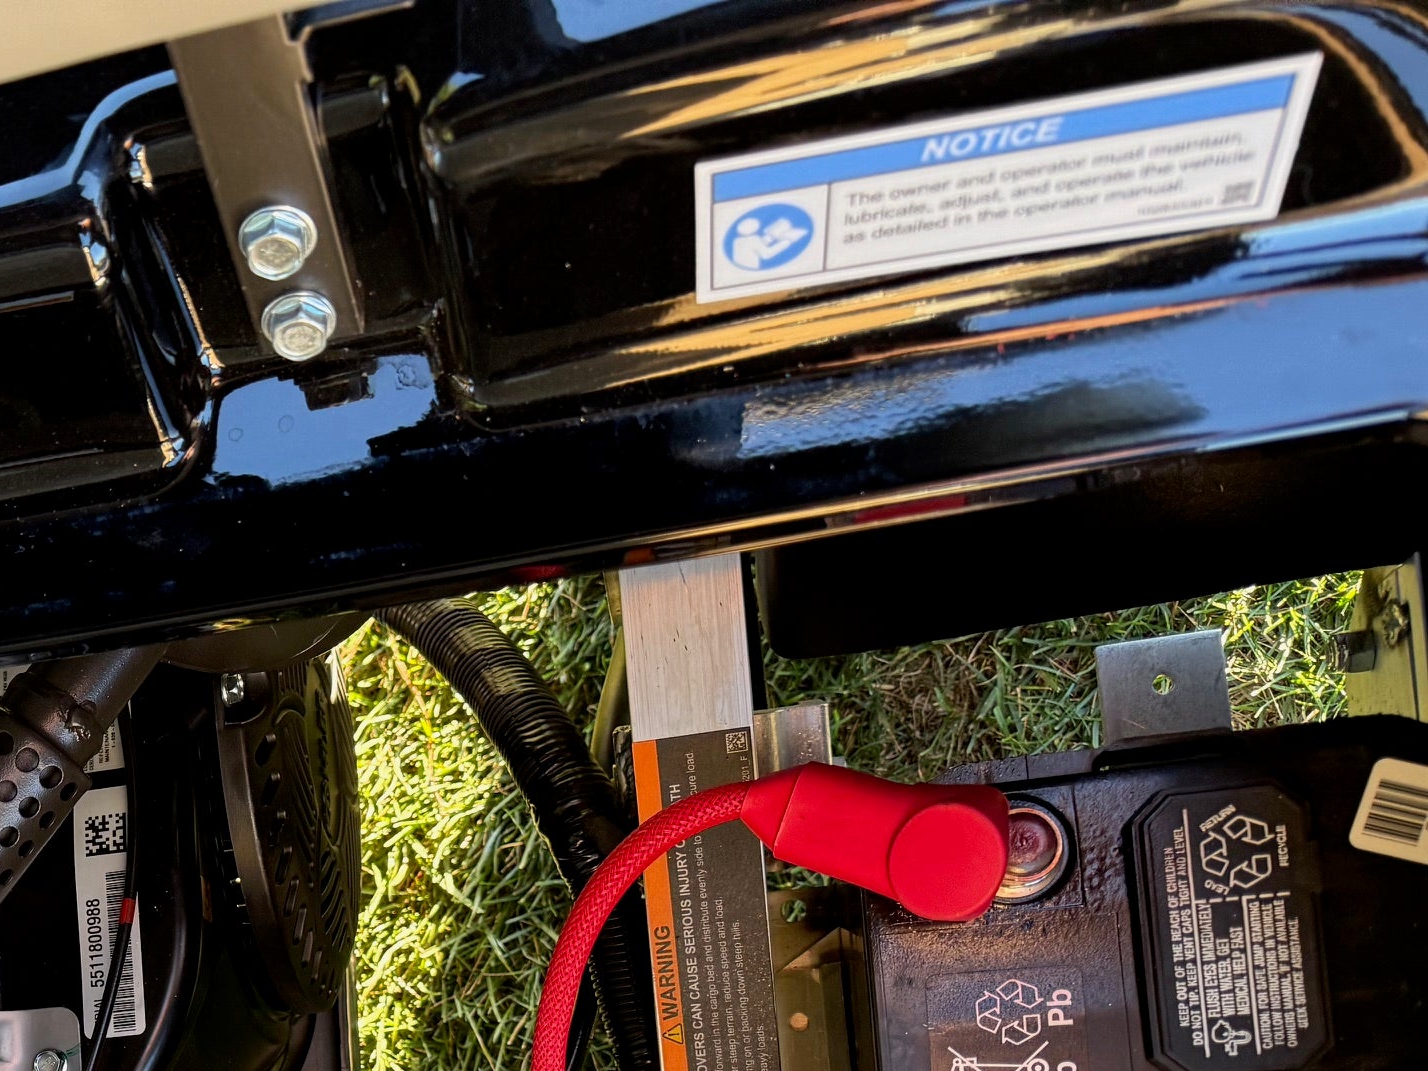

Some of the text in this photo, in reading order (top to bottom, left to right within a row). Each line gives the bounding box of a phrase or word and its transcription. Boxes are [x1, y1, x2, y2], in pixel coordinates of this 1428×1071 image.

[1276, 825, 1288, 866] RECYCLE
[676, 851, 690, 896] INJURY
[87, 898, 104, 988] 5511800988
[680, 899, 696, 954] SERIOUS
[731, 919, 740, 939] hills.
[1174, 827, 1203, 1045] DO NOT TIP. KEEP VENT CAPS TIGHT AND LEVEL
[654, 926, 678, 1020] WARNING
[733, 942, 745, 966] steep
[1198, 904, 1220, 1017] FLUSH EYES IMMEDIATELY
[1230, 927, 1249, 1015] MEDICAL HELP FAST
[686, 957, 700, 1000] CAUSE
[735, 969, 746, 994] down
[1216, 938, 1234, 1016] WITH WATER. GET
[691, 1003, 703, 1029] CAN
[739, 996, 751, 1031] backing
[1047, 988, 1074, 1026] Pb
[743, 1034, 750, 1043] or
[745, 1045, 752, 1057] on
